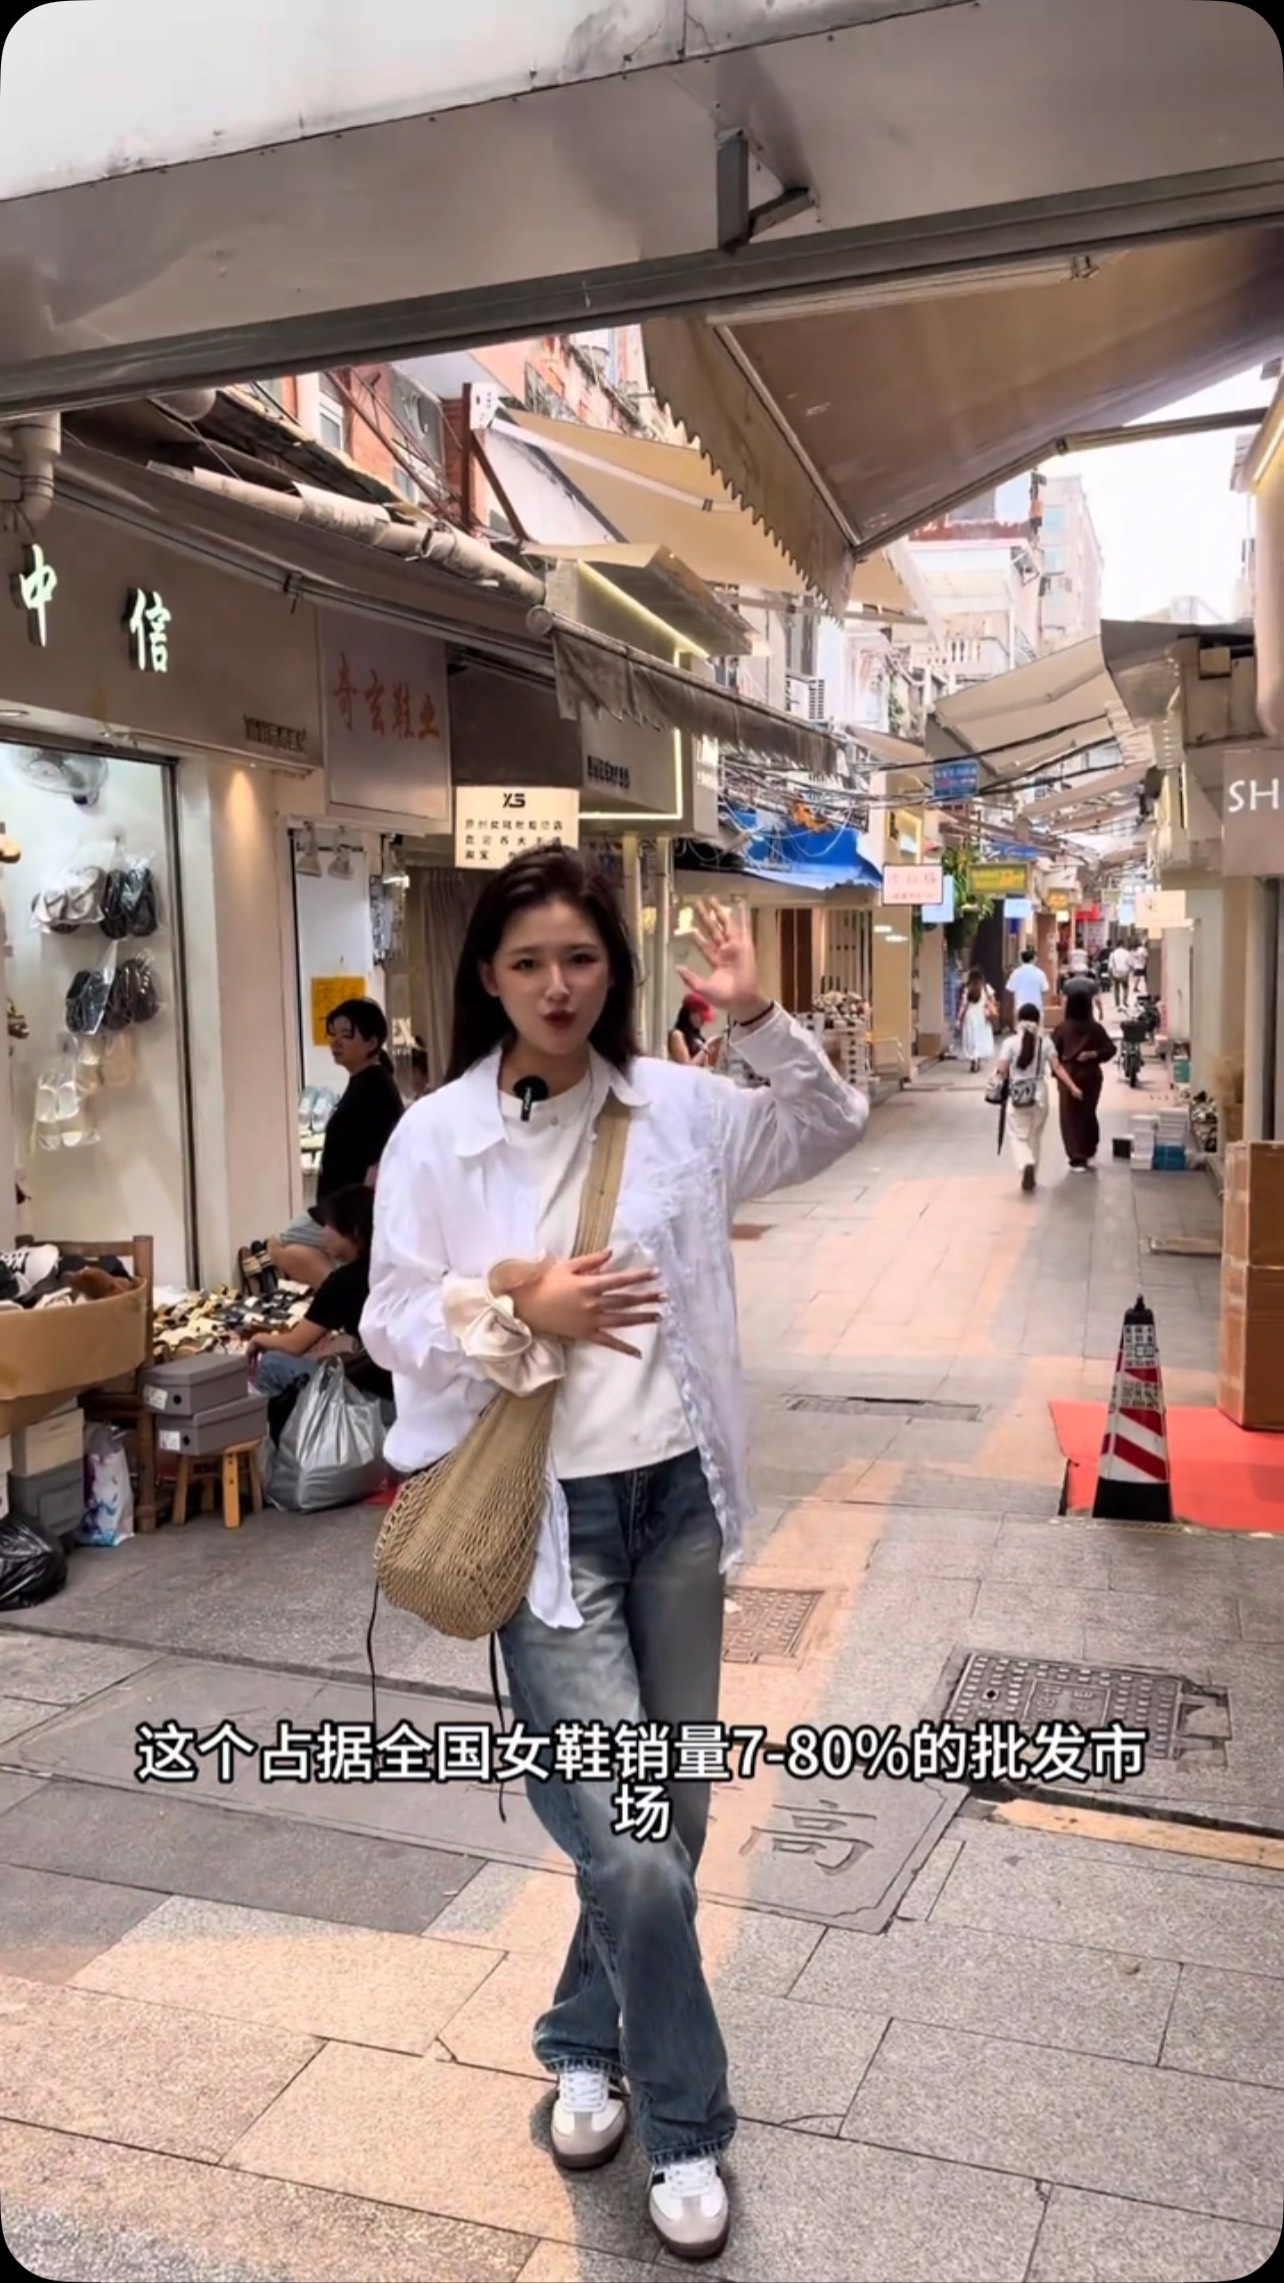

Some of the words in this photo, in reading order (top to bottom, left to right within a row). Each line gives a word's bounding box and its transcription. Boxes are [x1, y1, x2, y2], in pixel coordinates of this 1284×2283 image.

[19, 543, 172, 672] 中信
[1228, 778, 1279, 812] SH
[739, 1799, 877, 1876] 高
